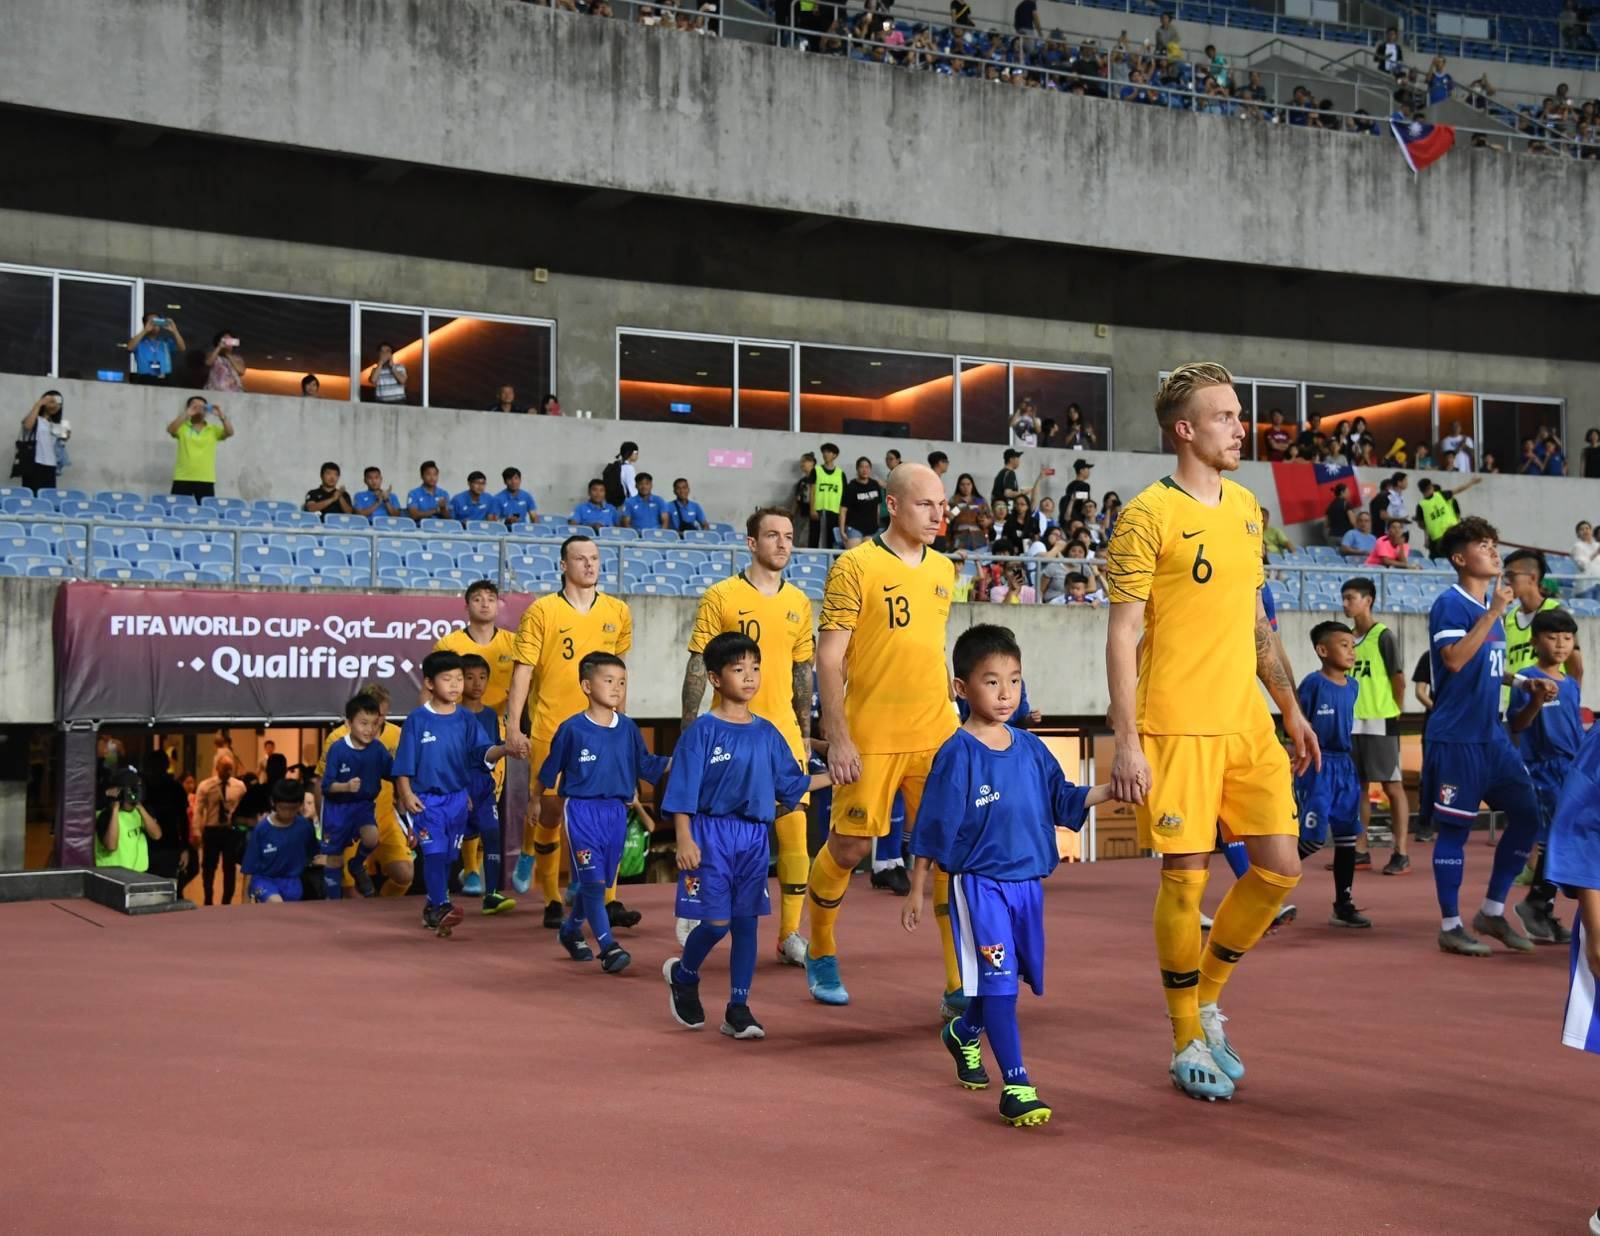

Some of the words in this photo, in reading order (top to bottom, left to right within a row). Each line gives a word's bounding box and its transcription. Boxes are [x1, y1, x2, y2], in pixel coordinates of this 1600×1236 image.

[1192, 543, 1213, 584] 6
[884, 595, 911, 629] 13
[110, 615, 168, 636] FIFA
[169, 615, 261, 637] WORLD
[264, 617, 312, 638] CUP
[738, 619, 761, 644] 10
[562, 637, 575, 660] 3
[211, 646, 395, 685] Qualifiers
[1489, 649, 1504, 677] 21
[1304, 811, 1318, 829] 6
